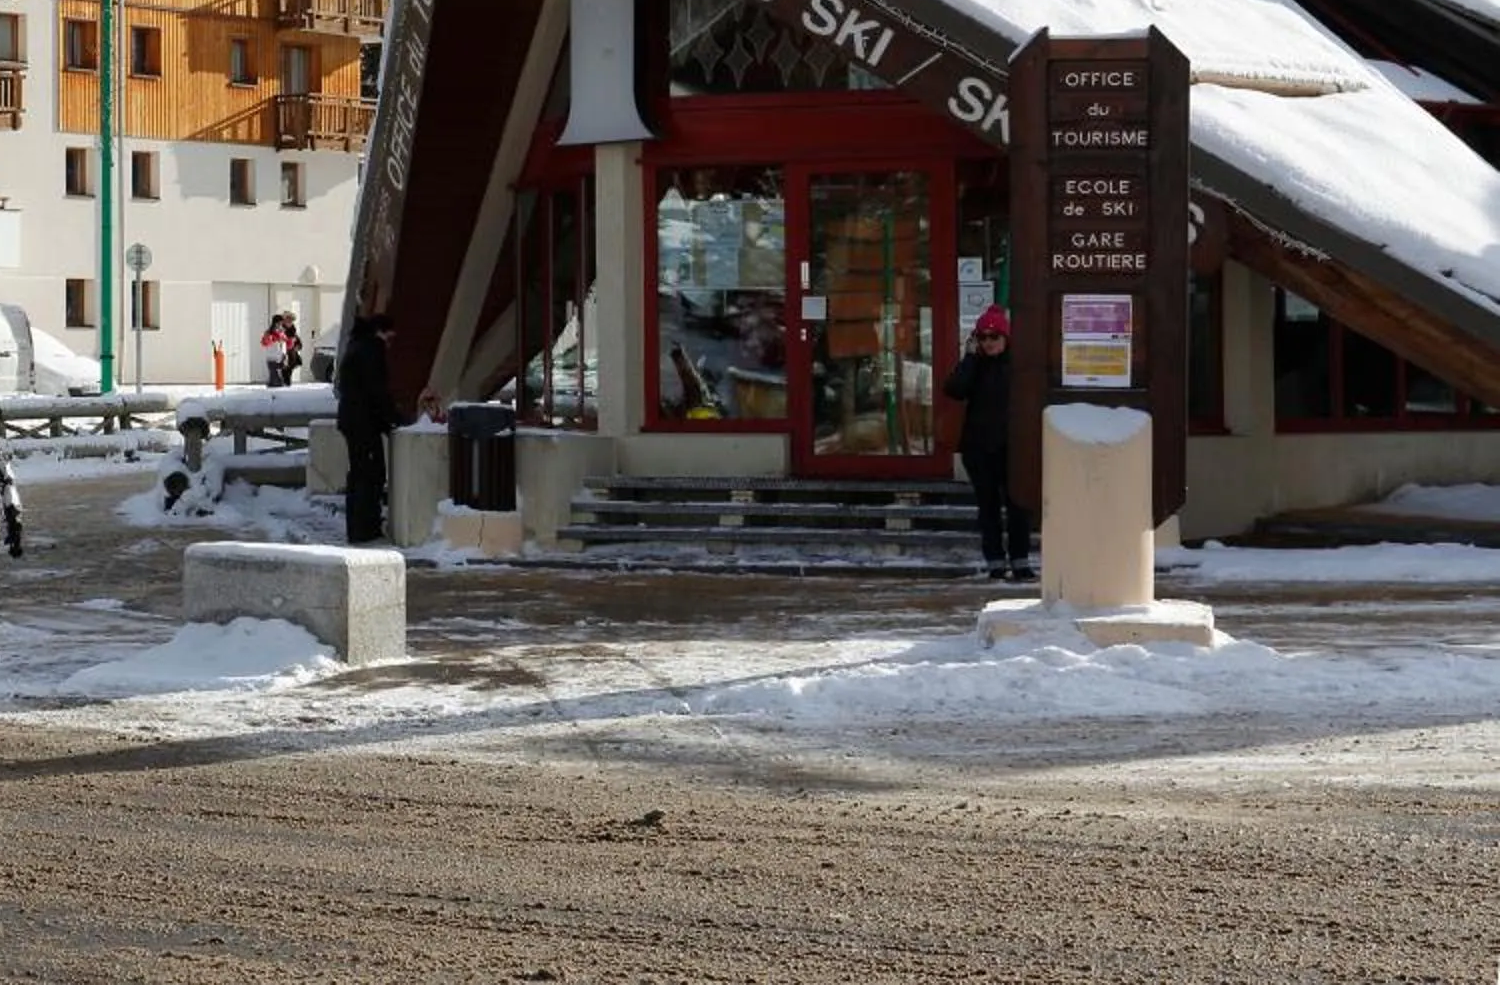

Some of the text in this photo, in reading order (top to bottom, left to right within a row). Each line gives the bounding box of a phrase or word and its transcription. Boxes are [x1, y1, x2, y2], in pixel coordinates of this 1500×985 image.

[1065, 72, 1134, 87] OFFICE
[387, 74, 417, 191] OFFICE
[406, 31, 425, 76] du
[947, 77, 1010, 144] SK
[1087, 102, 1109, 116] du
[1052, 130, 1149, 146] TOURISME
[1065, 180, 1131, 194] ECOLE
[1063, 201, 1133, 216] de SKI
[1071, 232, 1125, 248] GARE
[1053, 254, 1147, 269] ROUTIERE
